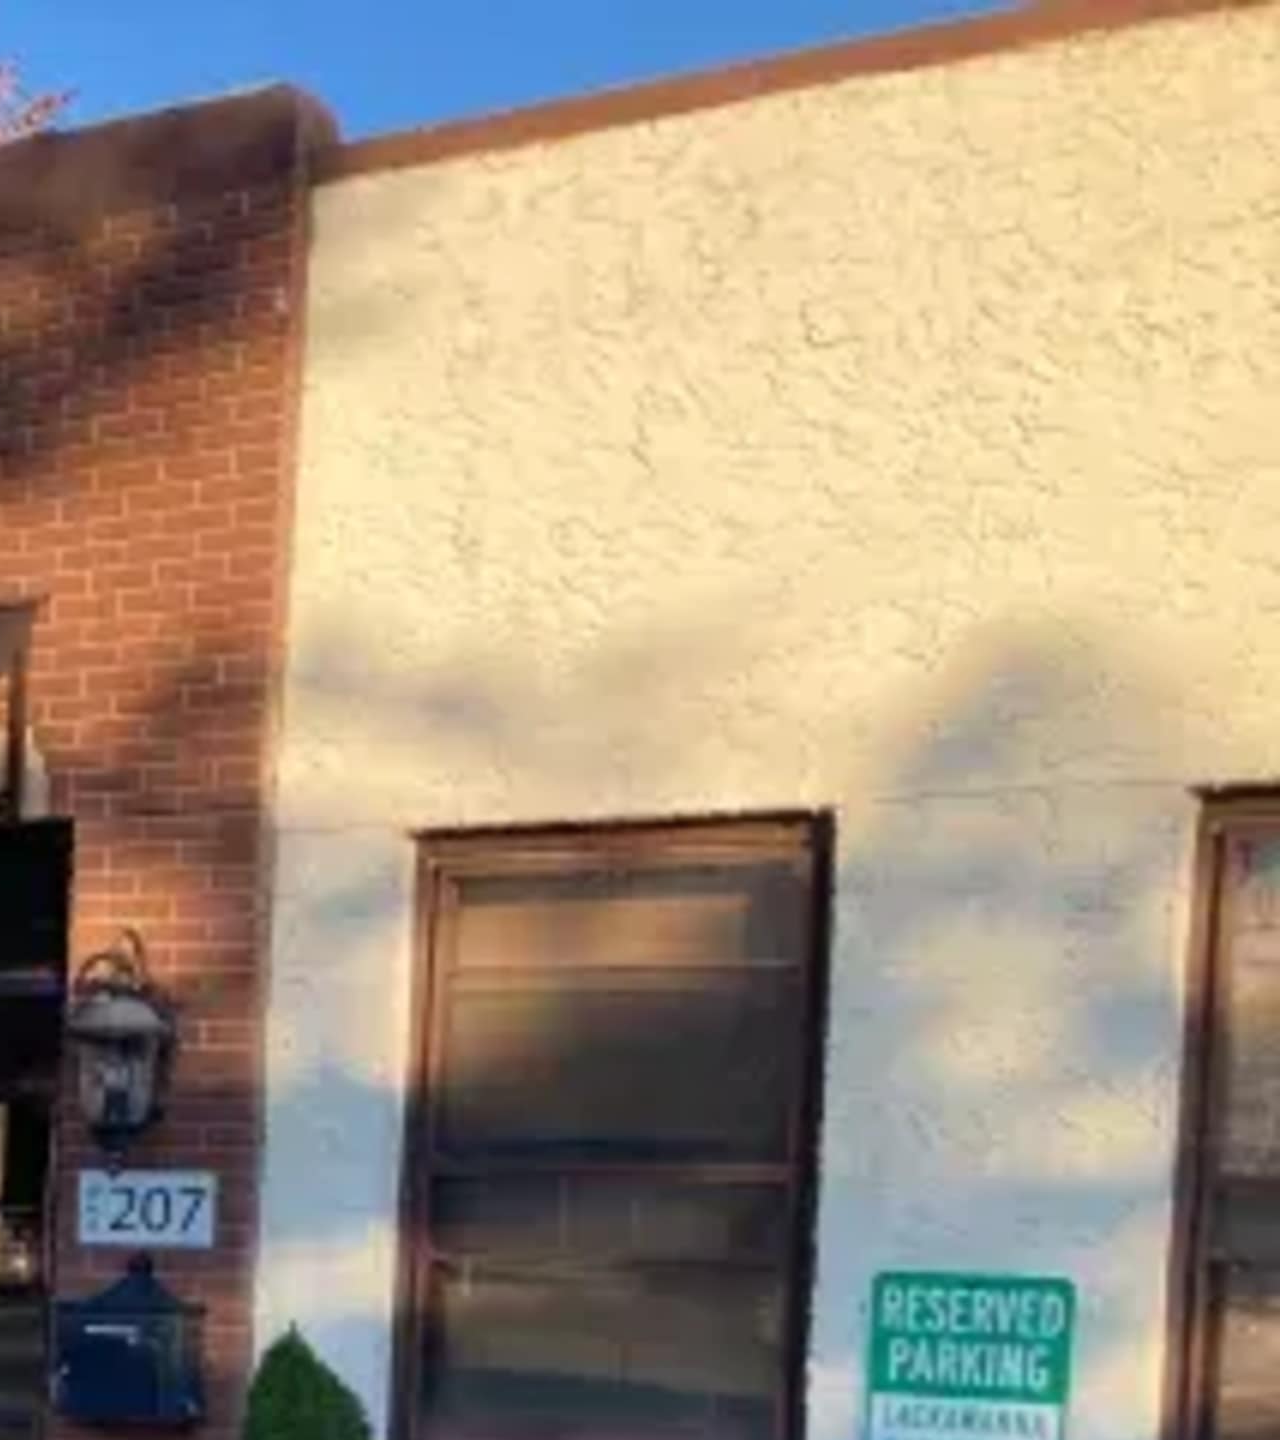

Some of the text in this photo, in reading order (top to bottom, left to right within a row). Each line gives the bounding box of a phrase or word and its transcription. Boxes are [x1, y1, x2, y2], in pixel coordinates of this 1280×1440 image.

[109, 1186, 207, 1232] 207
[881, 1285, 1065, 1337] RESERVED
[888, 1338, 1050, 1391] PARKING
